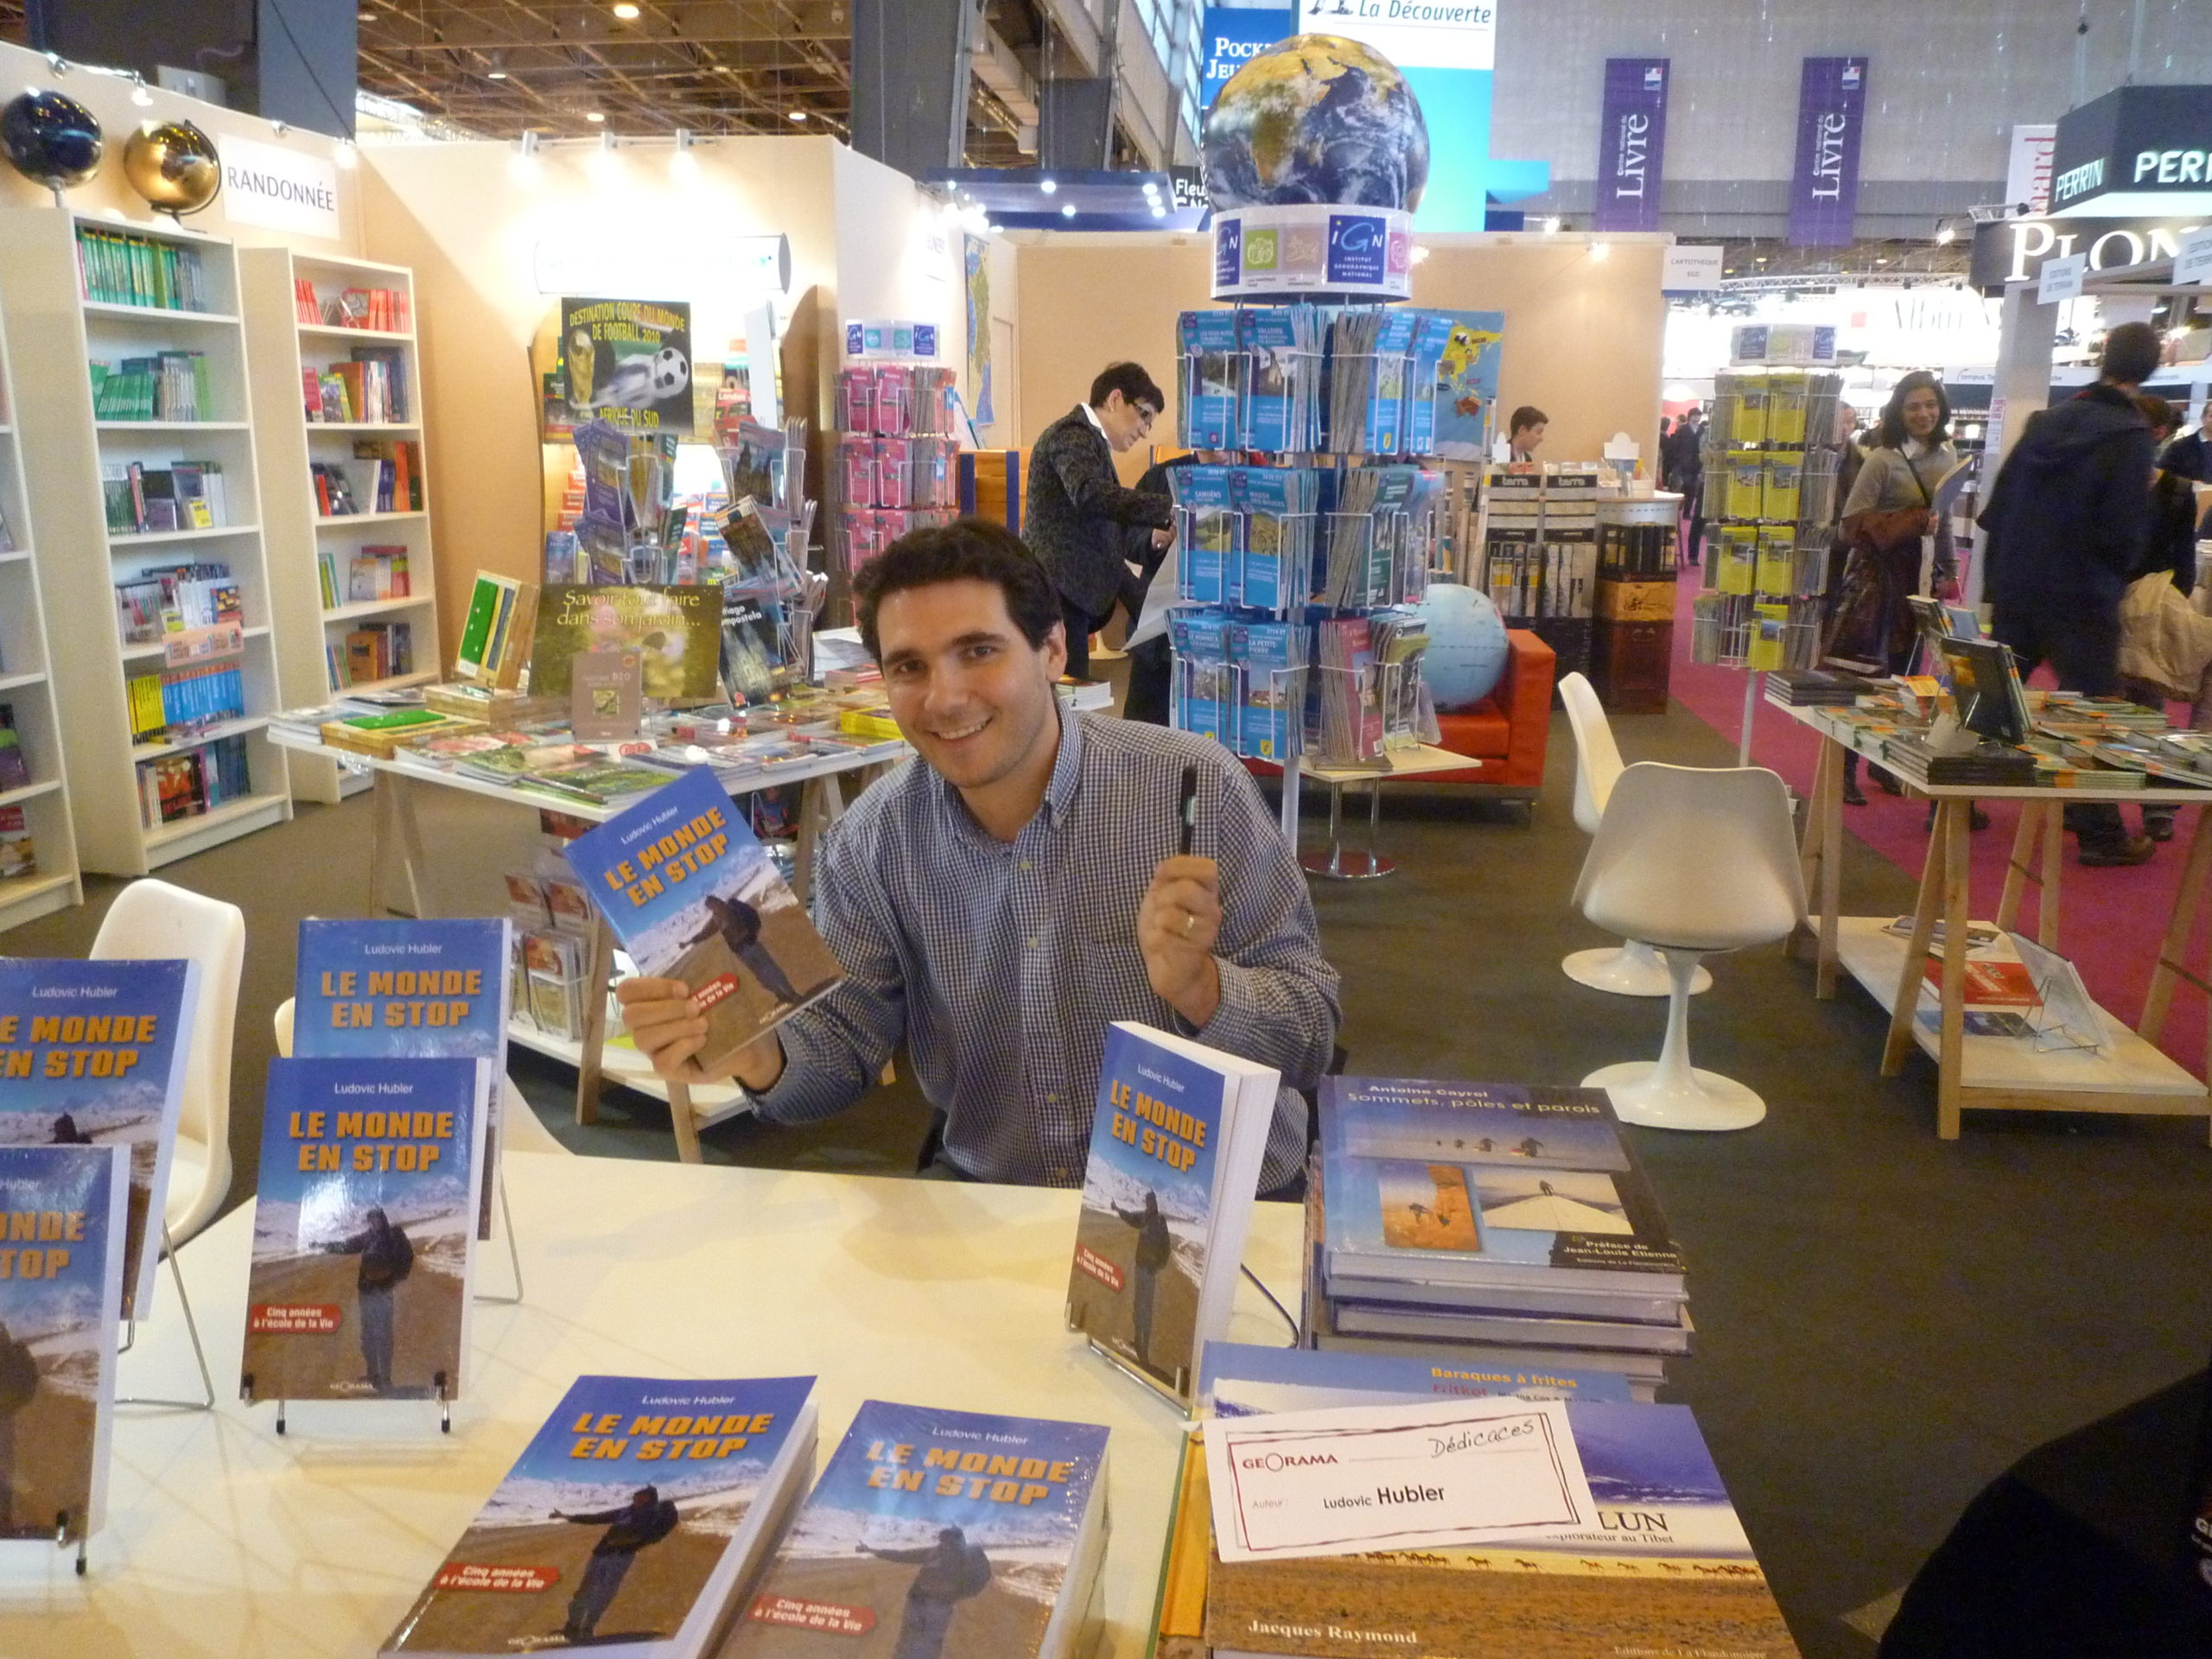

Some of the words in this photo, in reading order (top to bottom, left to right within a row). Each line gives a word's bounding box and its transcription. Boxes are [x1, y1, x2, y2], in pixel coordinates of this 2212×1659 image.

[1359, 1, 1379, 17] La
[1391, 0, 1491, 24] Découverte
[1616, 113, 1649, 200] Livre
[1812, 113, 1846, 200] Livre
[227, 166, 334, 212] RANDONNÉE
[2055, 157, 2106, 202] PERRIN
[569, 303, 614, 327] DESTINATION
[617, 302, 641, 321] COUPE
[643, 304, 656, 323] DU
[658, 308, 685, 332] MONDE
[593, 323, 602, 340] DE
[604, 322, 639, 341] FOOTBALL
[643, 329, 661, 342] 2010
[718, 391, 747, 401] London
[644, 410, 659, 429] SUD
[1558, 476, 1586, 486] terra
[563, 589, 614, 607] Savoir
[556, 604, 599, 626] dans
[620, 823, 653, 845] Ludovic
[652, 805, 678, 826] Hubler
[604, 860, 638, 891] LE
[638, 805, 728, 871] MONDE
[626, 874, 664, 906] EN
[665, 833, 728, 883] STOP
[365, 944, 405, 955] Ludovic
[408, 944, 442, 955] Hubler
[32, 987, 77, 998] Ludovic
[80, 987, 118, 998] Hubler
[321, 971, 357, 996] LE
[367, 970, 481, 996] MONDE
[332, 1002, 373, 1028] EN
[385, 1001, 469, 1027] STOP
[30, 1015, 157, 1043] MONDE
[44, 1049, 138, 1077] STOP
[334, 1084, 375, 1094] Ludovic
[378, 1084, 413, 1094] Hubler
[1137, 1064, 1162, 1083] Ludovic
[1163, 1075, 1185, 1093] Hubler
[1369, 1084, 1431, 1095] Antoine
[1110, 1079, 1132, 1110] LE
[1135, 1091, 1207, 1148] MONDE
[1538, 1103, 1600, 1114] parois
[289, 1111, 326, 1138] LE
[336, 1111, 454, 1138] MONDE
[1111, 1111, 1137, 1146] EN
[1141, 1128, 1196, 1173] STOP
[298, 1144, 340, 1171] EN
[353, 1144, 440, 1172] STOP
[1563, 1247, 1629, 1256] Jean-Louis
[1586, 1241, 1631, 1249] Préface
[253, 1318, 260, 1329] à
[262, 1318, 292, 1329] l'école
[295, 1318, 306, 1329] de
[308, 1318, 317, 1329] la
[320, 1318, 334, 1329] Vie
[267, 1307, 287, 1319] Cinq
[289, 1306, 322, 1318] années
[1432, 1368, 1511, 1382] Baraques
[1516, 1374, 1526, 1383] à
[1532, 1375, 1578, 1389] frites
[641, 1395, 690, 1405] Ludovic
[693, 1395, 736, 1405] Hubler
[571, 1413, 622, 1434] LE
[628, 1414, 774, 1435] MONDE
[932, 1427, 982, 1441] Ludovic
[985, 1432, 1029, 1446] Hubler
[1428, 1419, 1535, 1459] Dédicaces
[570, 1438, 629, 1459] EN
[635, 1439, 747, 1460] STOP
[866, 1440, 914, 1464] LE
[924, 1447, 1071, 1484] MONDE
[1243, 1452, 1338, 1471] GEORAMA
[868, 1467, 925, 1492] EN
[935, 1475, 1050, 1505] STOP
[1323, 1497, 1372, 1510] Ludovic
[1377, 1484, 1445, 1505] Hubler
[1639, 1534, 1675, 1543] Tibet
[462, 1566, 490, 1580] Cinq
[493, 1578, 509, 1588] de
[754, 1605, 763, 1618] à
[809, 1614, 825, 1626] de
[827, 1617, 840, 1629] la
[842, 1619, 862, 1631] Vie
[776, 1599, 804, 1612] Cinq
[805, 1604, 850, 1618] années
[1249, 1620, 1321, 1638] Jacques
[1327, 1625, 1417, 1643] Raymond
[1662, 1648, 1676, 1656] de
